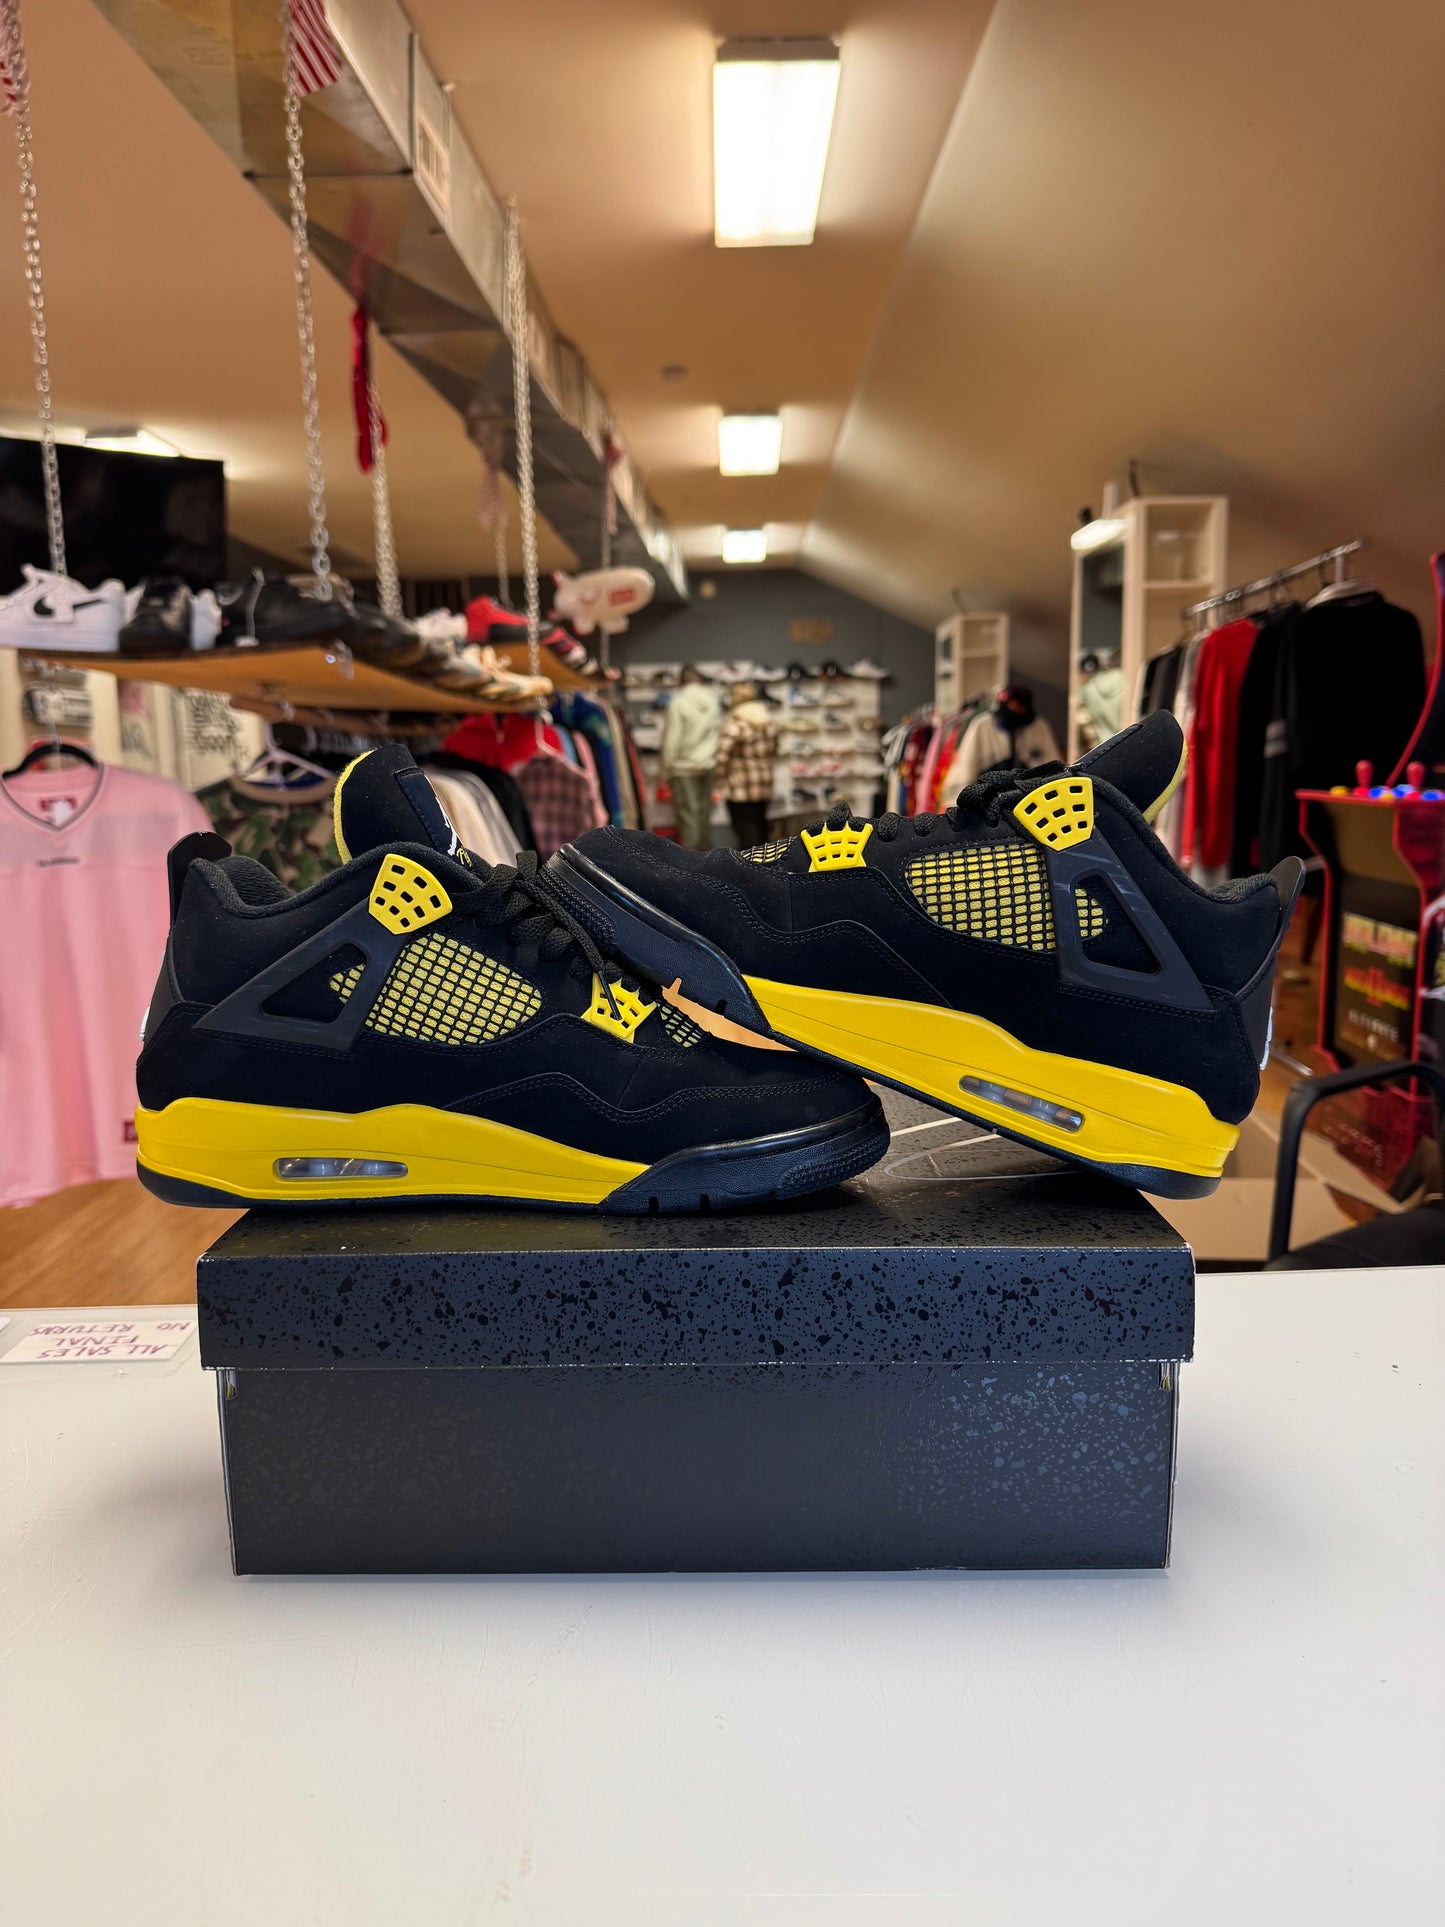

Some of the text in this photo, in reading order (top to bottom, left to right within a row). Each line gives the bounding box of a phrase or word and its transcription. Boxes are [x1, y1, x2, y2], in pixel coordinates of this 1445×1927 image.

[32, 1322, 191, 1336] NO RETURNS
[52, 1335, 140, 1346] FINAL
[37, 1344, 168, 1359] ALL SALES
